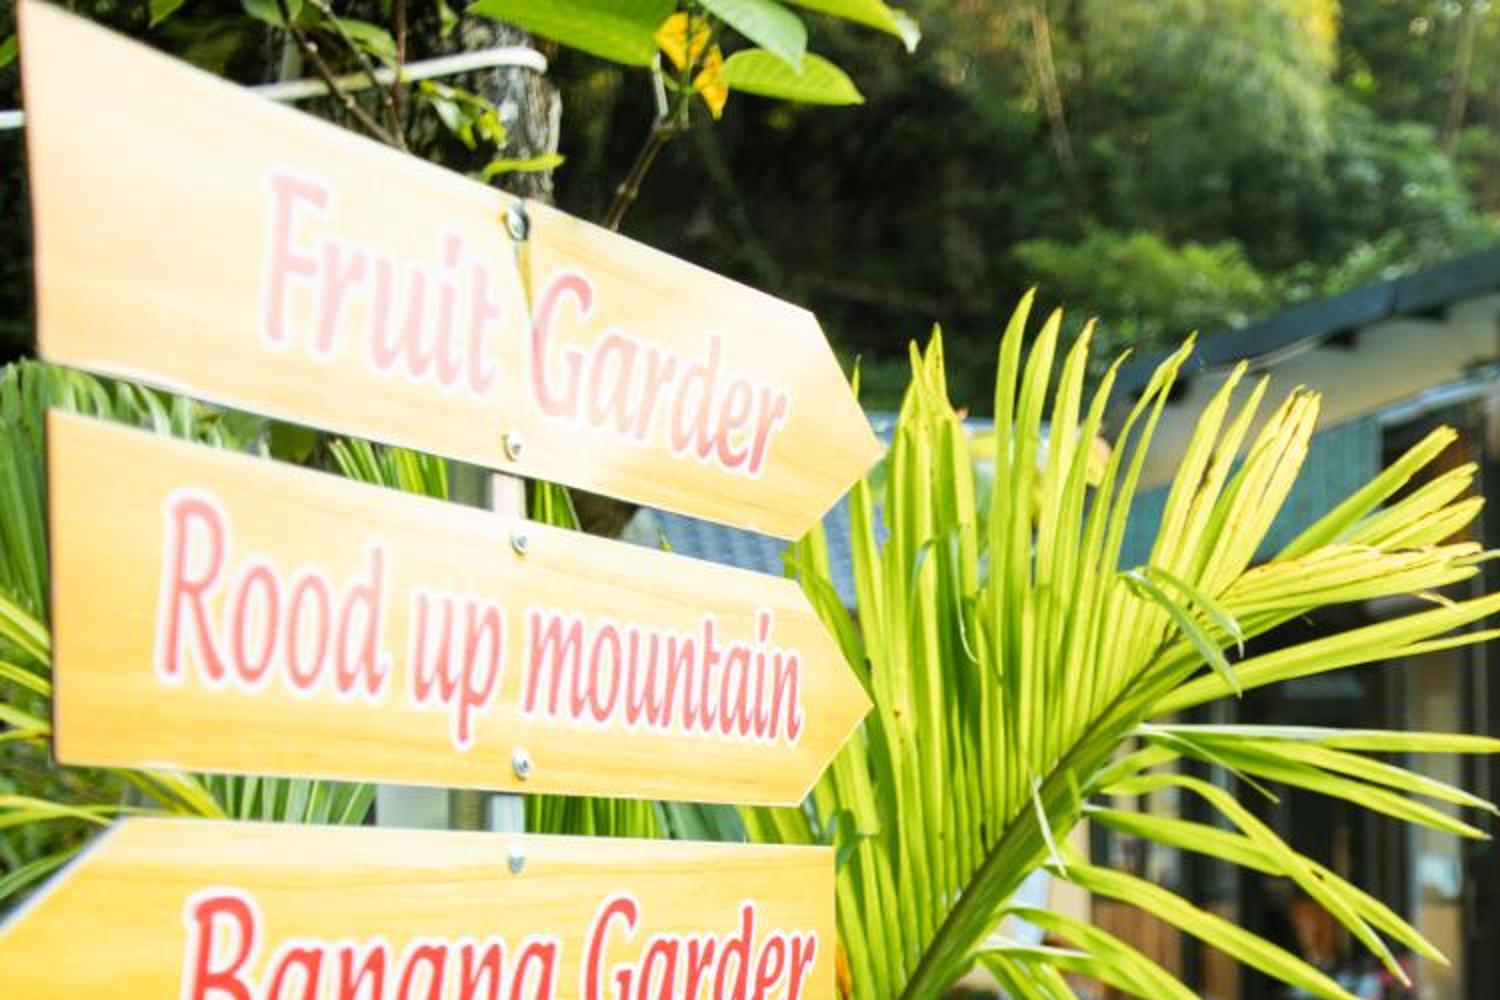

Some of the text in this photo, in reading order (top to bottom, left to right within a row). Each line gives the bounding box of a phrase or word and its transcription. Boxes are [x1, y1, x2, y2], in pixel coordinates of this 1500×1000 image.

[262, 175, 786, 475] Fruit Garder
[163, 497, 802, 743] Rood up mountain
